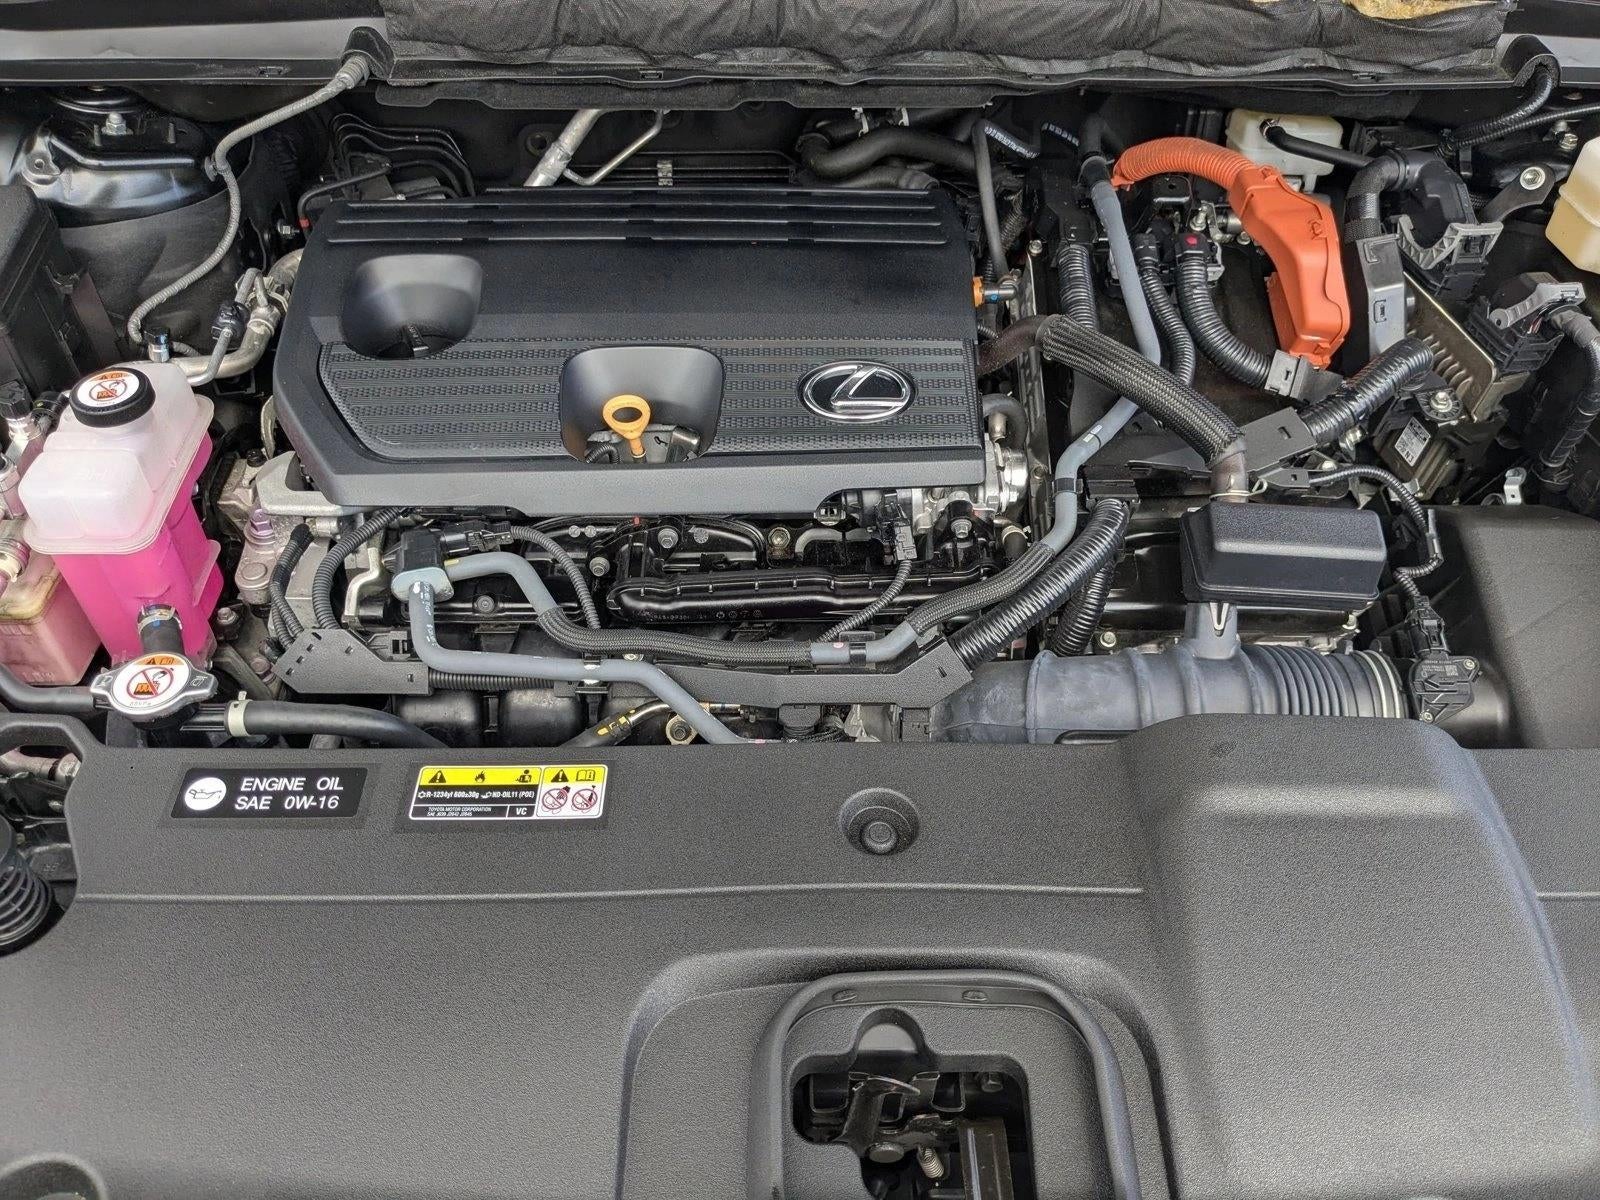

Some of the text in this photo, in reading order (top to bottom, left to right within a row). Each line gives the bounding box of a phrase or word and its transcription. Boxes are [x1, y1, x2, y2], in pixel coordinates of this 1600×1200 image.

[240, 777, 344, 791] ENGINE OIL
[234, 795, 340, 810] SAE 0W-16
[516, 807, 528, 815] VC
